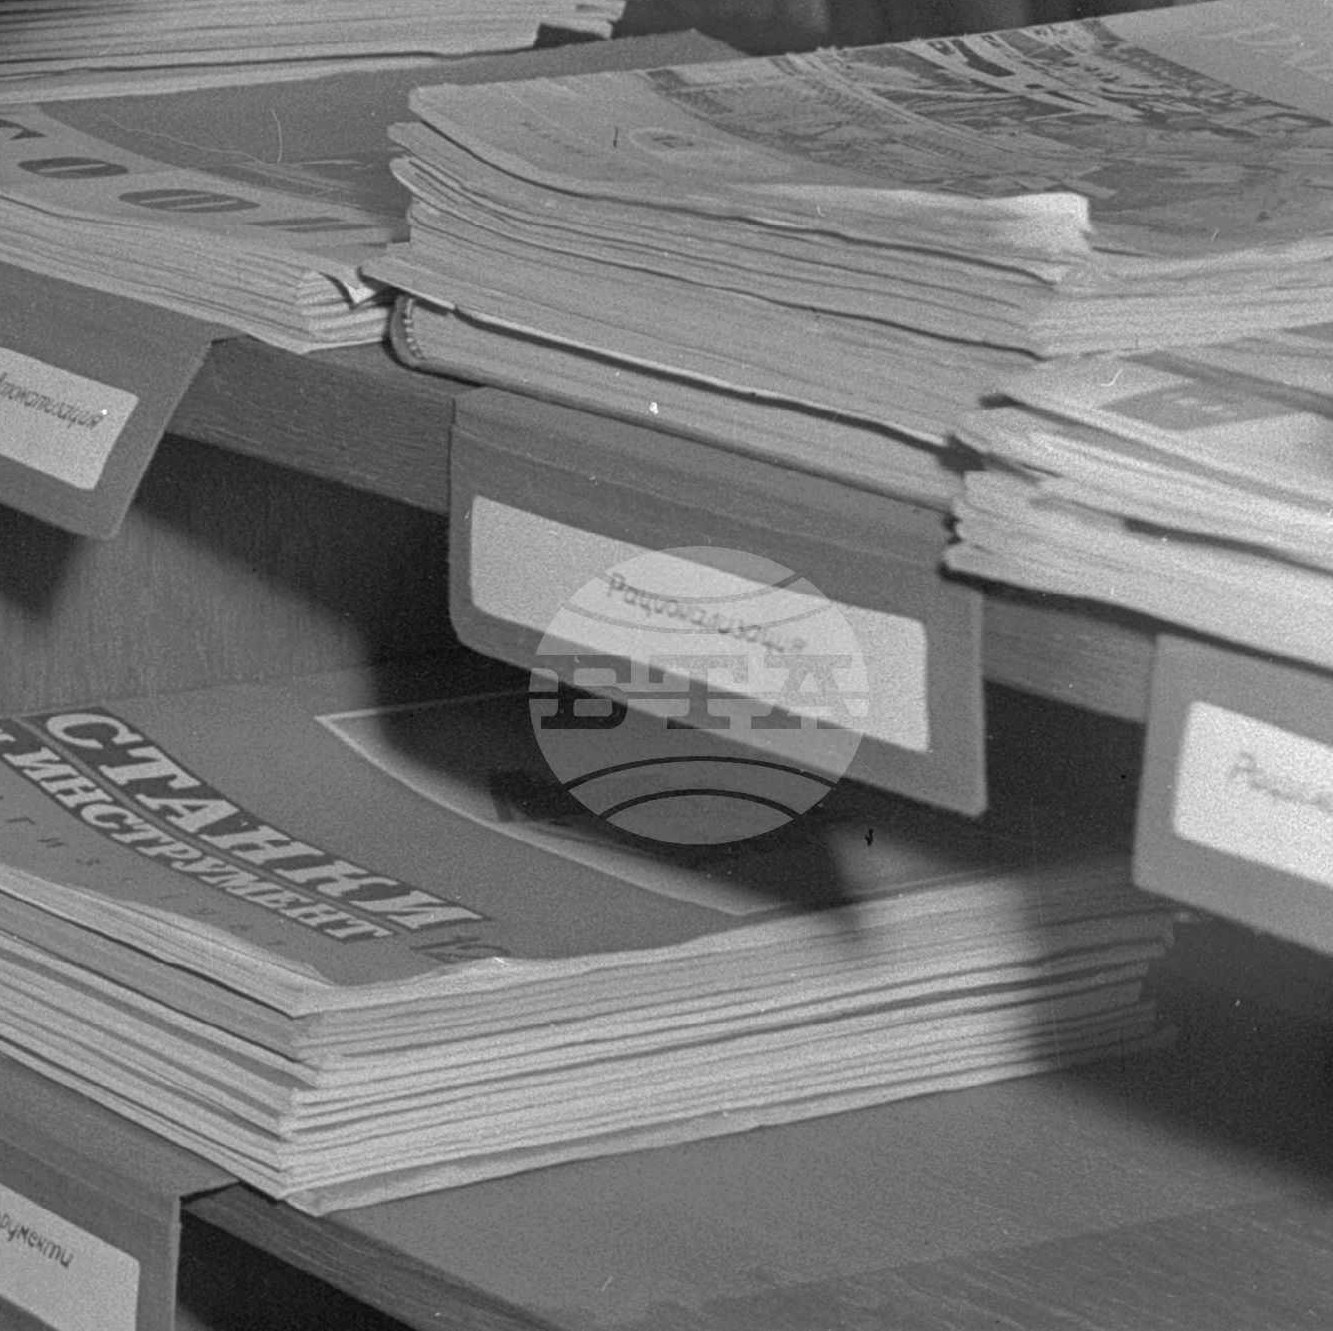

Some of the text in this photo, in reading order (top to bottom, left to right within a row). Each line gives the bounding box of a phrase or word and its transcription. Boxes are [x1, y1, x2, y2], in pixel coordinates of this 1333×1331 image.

[607, 571, 808, 655] Рационализация
[3, 746, 395, 939] ИНСТРУМЕНТ
[46, 712, 486, 930] СТАНКИ
